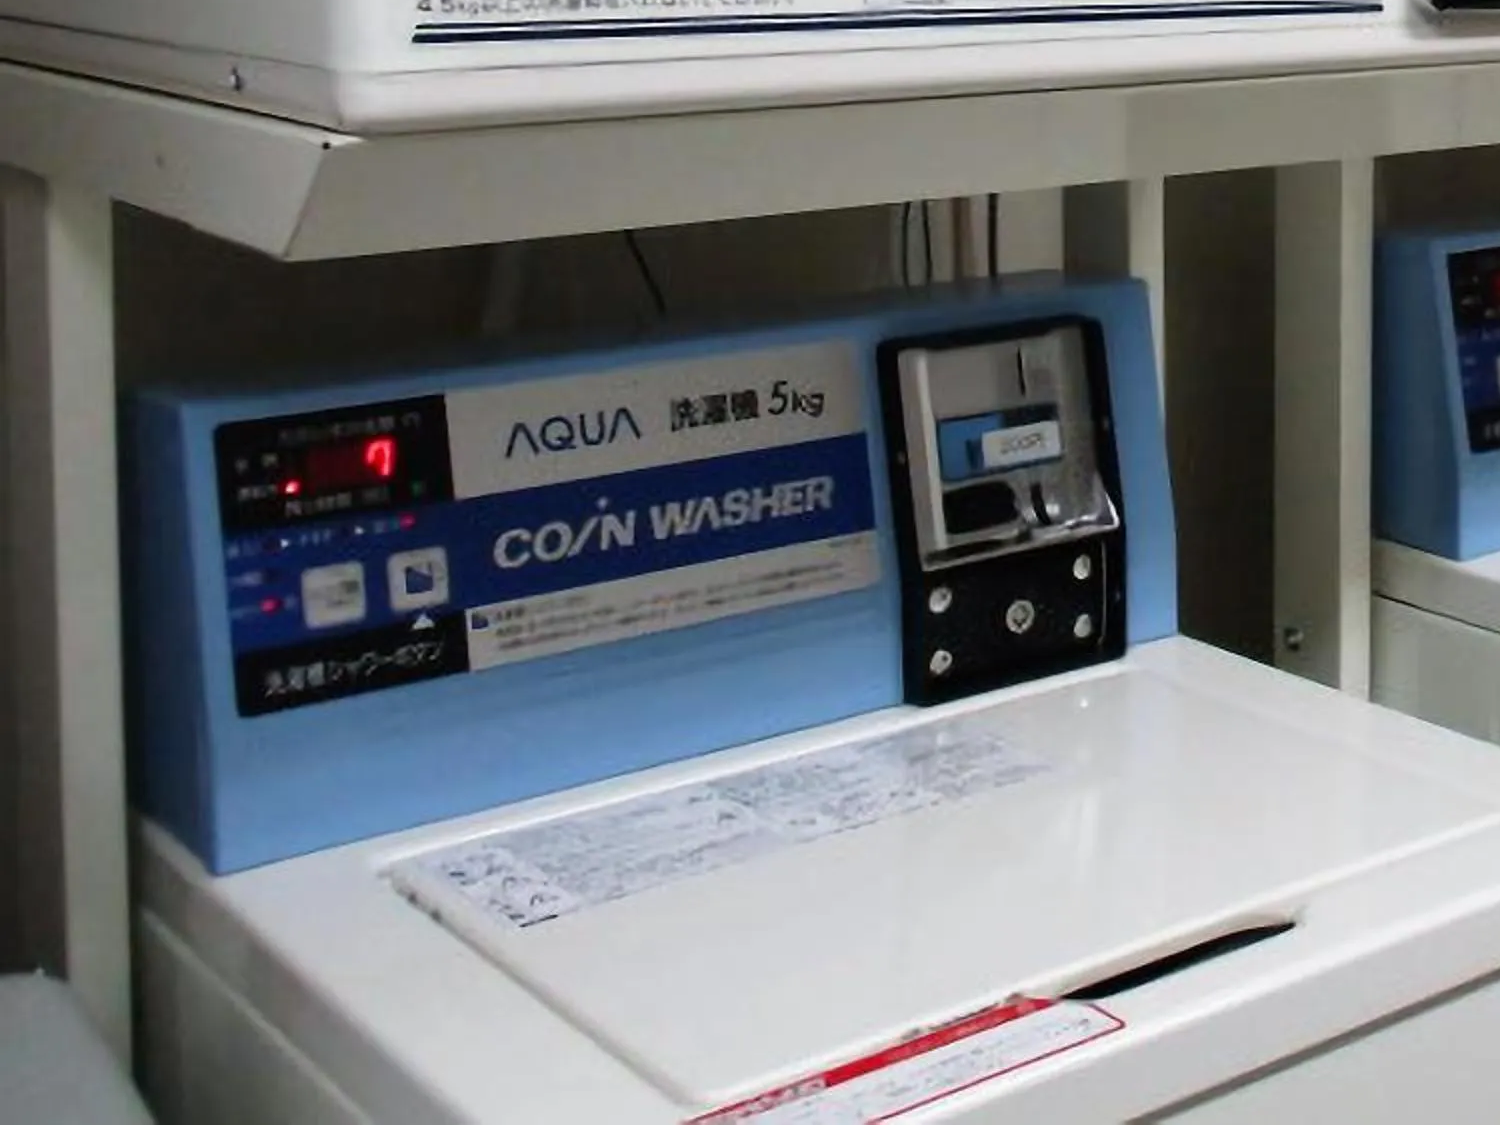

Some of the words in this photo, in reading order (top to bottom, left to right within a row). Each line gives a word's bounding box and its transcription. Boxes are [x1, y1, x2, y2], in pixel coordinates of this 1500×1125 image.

[365, 437, 394, 477] 7
[504, 406, 643, 459] AQUA
[767, 380, 825, 418] 5kg
[492, 496, 637, 568] COIN
[649, 475, 833, 541] WASHER
